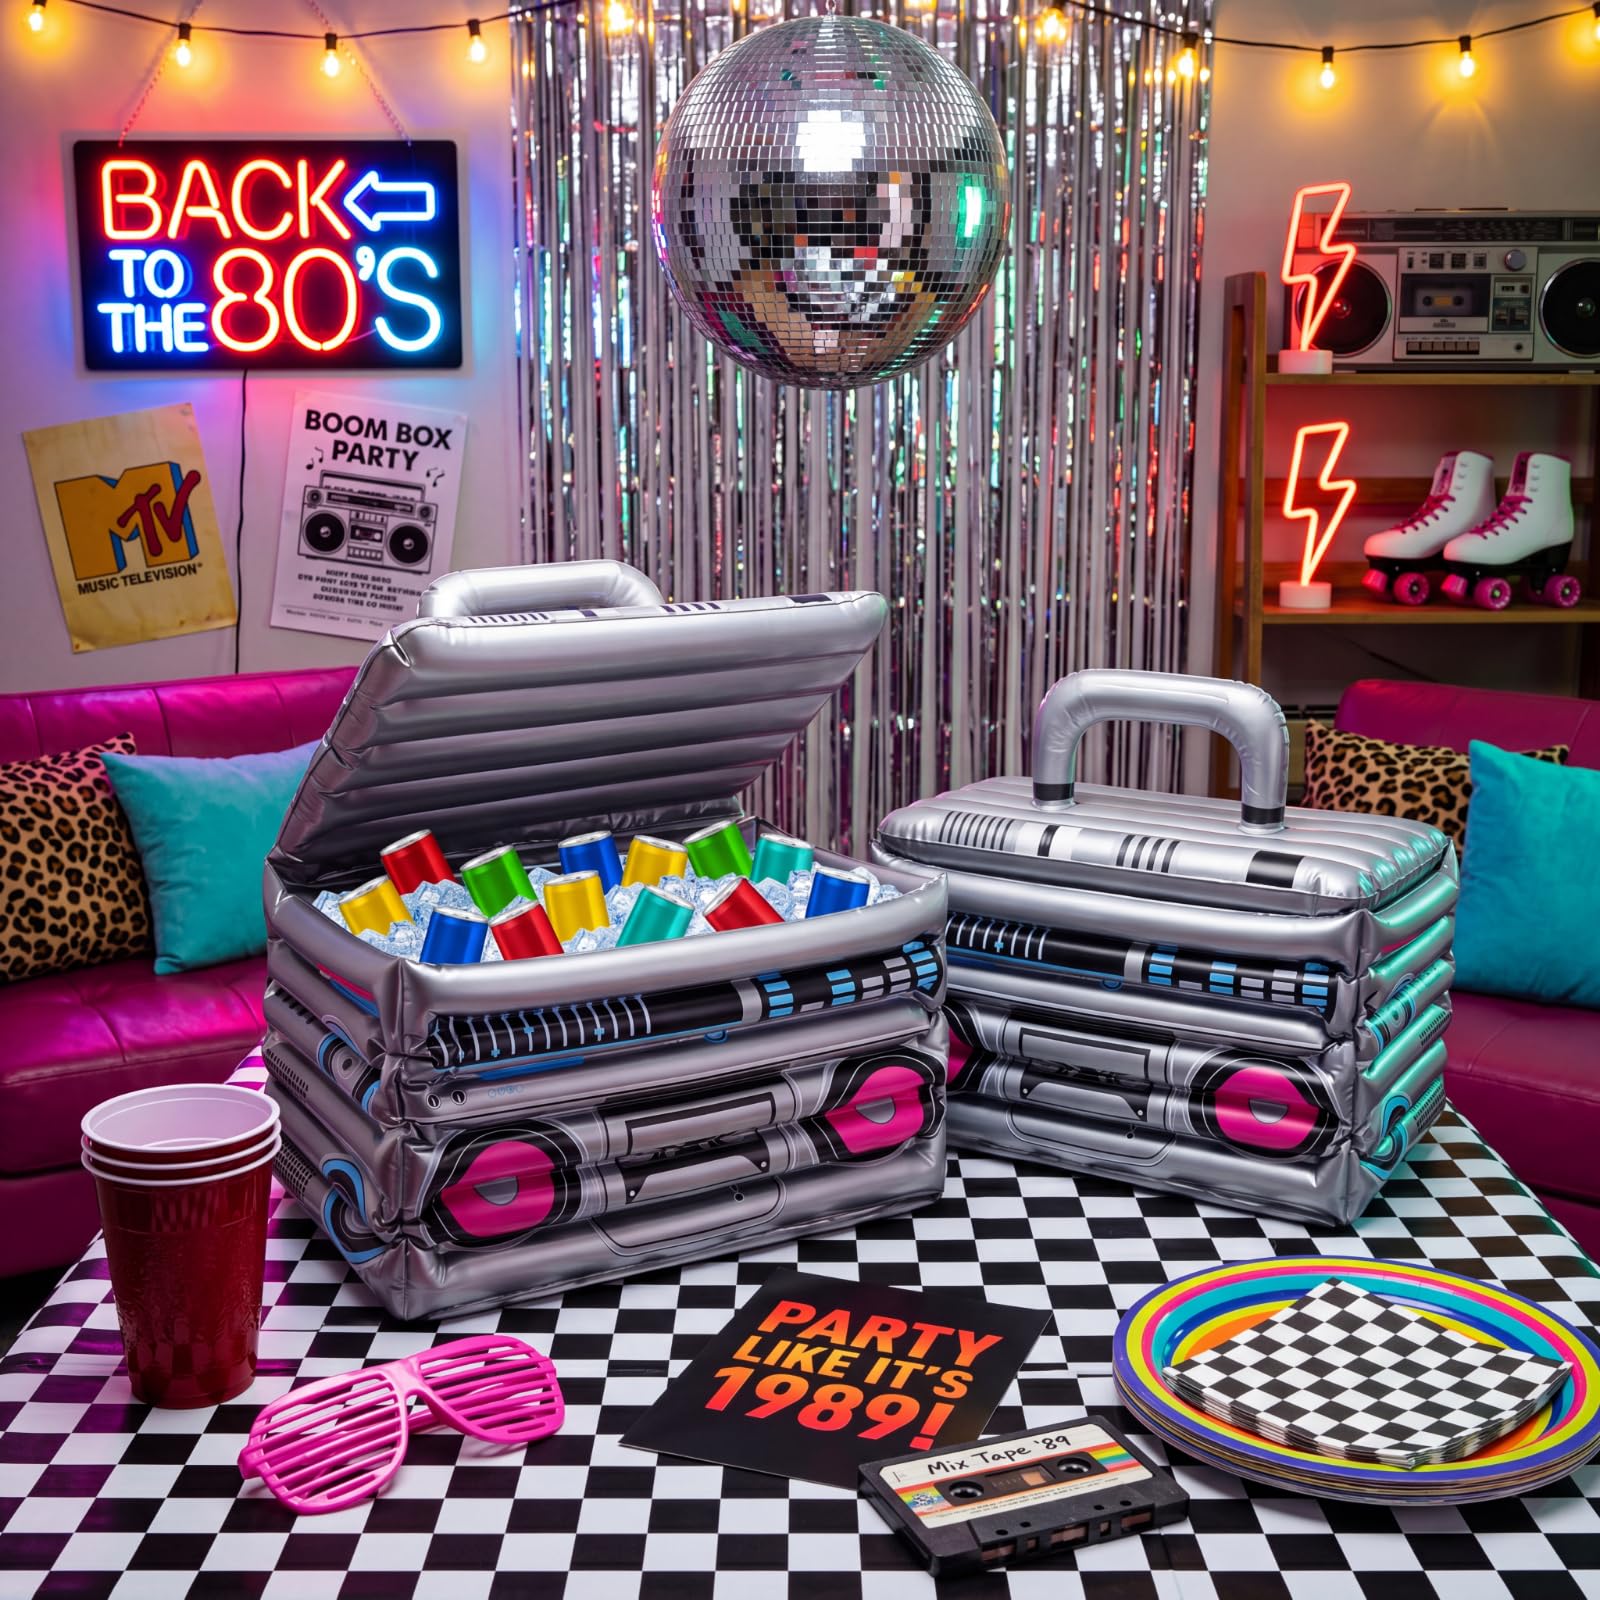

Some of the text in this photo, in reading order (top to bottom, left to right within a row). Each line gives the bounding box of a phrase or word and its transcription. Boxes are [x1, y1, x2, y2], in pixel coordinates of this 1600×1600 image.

[101, 159, 352, 241] BACK
[108, 248, 186, 299] TO
[210, 245, 442, 353] 80'S
[97, 302, 210, 353] THE
[304, 409, 453, 450] BOOM BOX
[331, 439, 419, 472] PARTY
[54, 461, 201, 581] MTV
[77, 576, 120, 596] MUSIC
[757, 1300, 1003, 1368] PARTY
[733, 1335, 975, 1400] LIKE IT'S
[704, 1365, 955, 1451] 1989!
[927, 1435, 1072, 1475] Mix Tape '89
